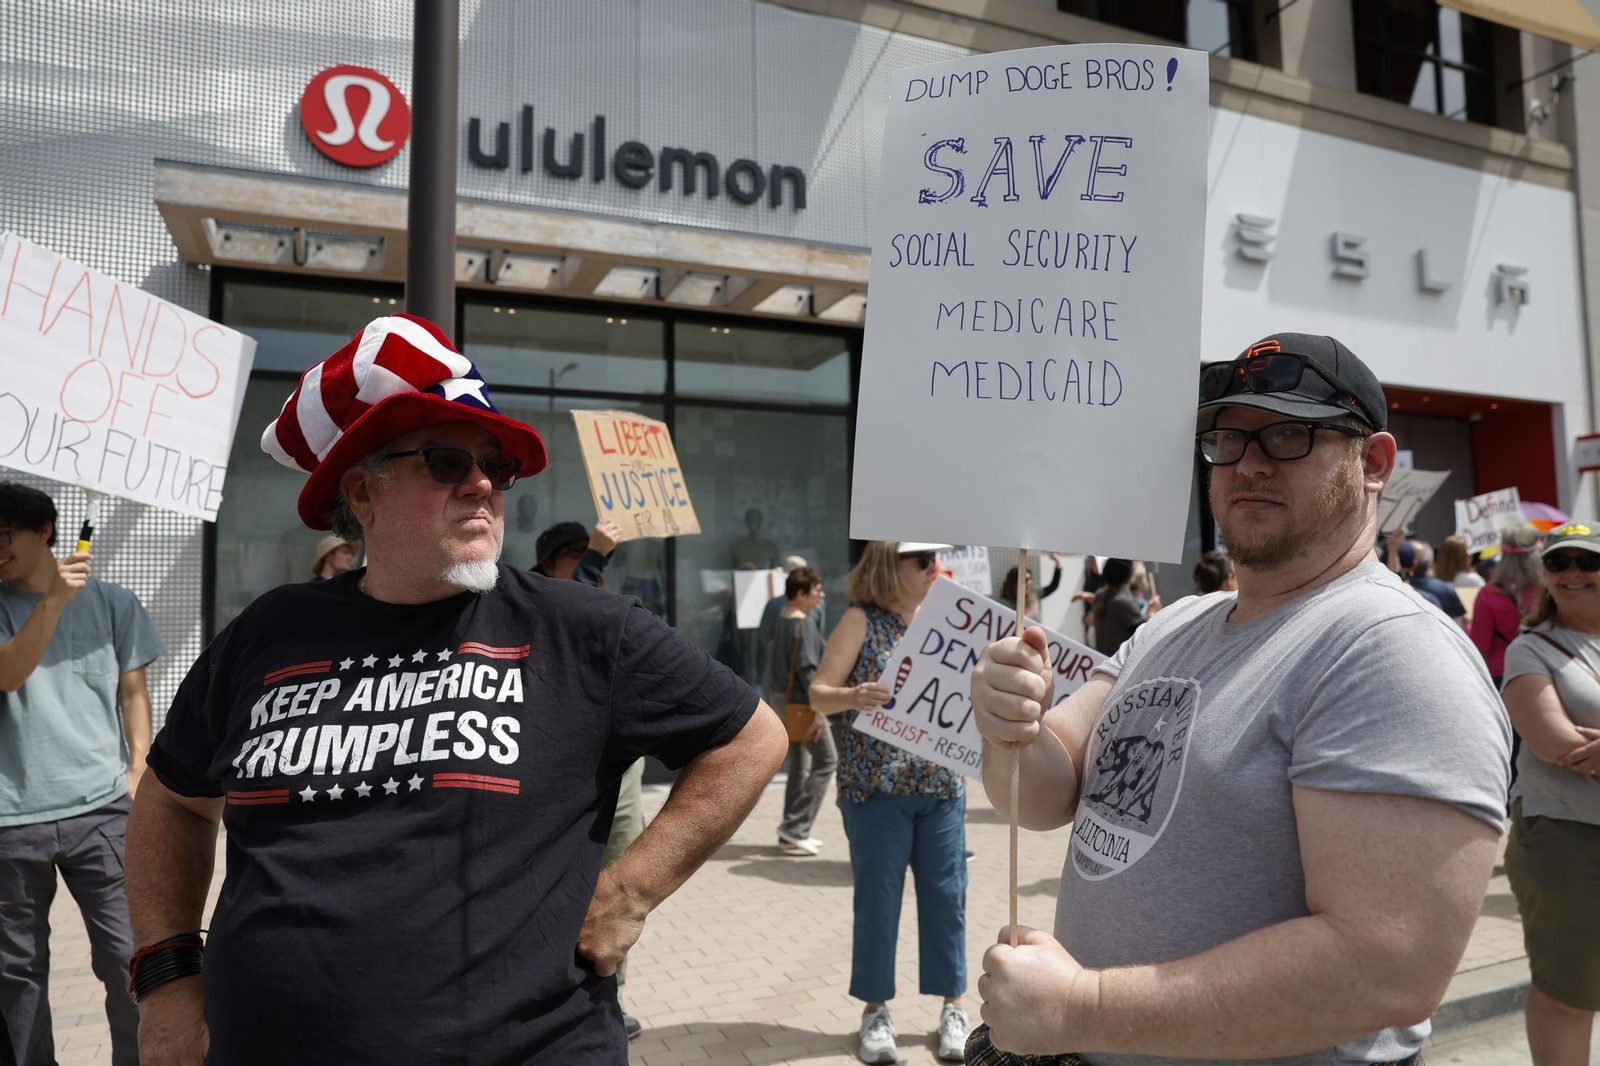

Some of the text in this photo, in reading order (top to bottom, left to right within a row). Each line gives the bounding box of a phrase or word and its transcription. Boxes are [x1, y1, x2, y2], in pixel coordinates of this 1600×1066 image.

[905, 70, 989, 102] DUMP
[1005, 61, 1072, 92] DOGE
[468, 104, 807, 210] ululemon
[918, 135, 1133, 206] SAVE
[889, 229, 1137, 273] SOCIAL SECURITY
[1235, 212, 1531, 306] ESLA
[2, 241, 226, 399] HANDS
[936, 298, 1119, 341] MEDICARE
[60, 358, 180, 436] OFF
[931, 359, 1123, 407] MEDICAID
[98, 428, 228, 512] FUTURE
[600, 467, 688, 511] JUSTICE
[945, 597, 1026, 642] SAV
[249, 661, 524, 730] KEEP AMERICA
[231, 710, 521, 778] TRUMPLESS
